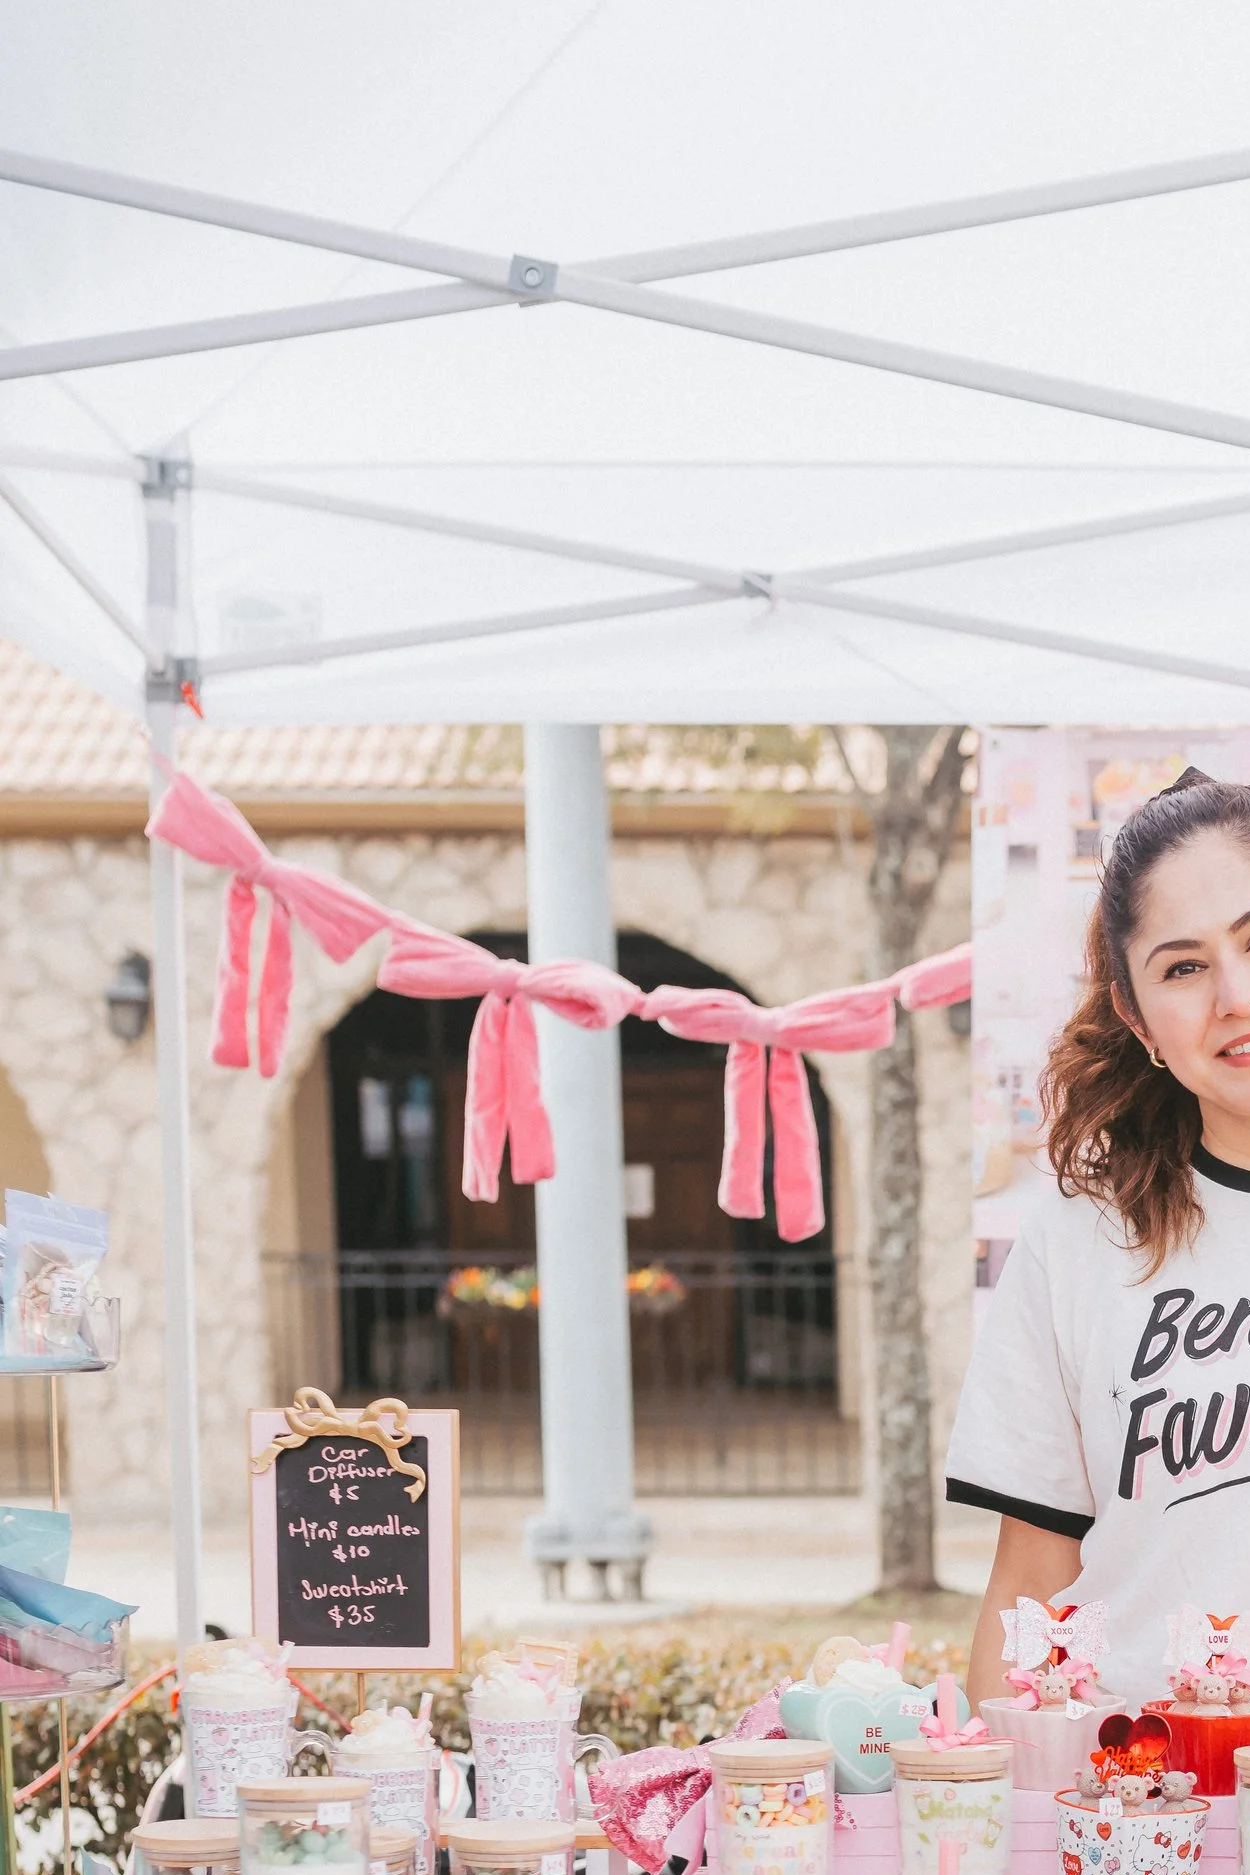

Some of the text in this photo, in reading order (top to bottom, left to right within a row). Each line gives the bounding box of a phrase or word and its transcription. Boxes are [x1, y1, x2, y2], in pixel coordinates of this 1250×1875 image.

[321, 1446, 369, 1462] Car
[308, 1463, 395, 1483] Diffuser
[329, 1483, 360, 1505] $5
[288, 1515, 421, 1547] Mini candles
[332, 1544, 370, 1563] $10
[301, 1574, 409, 1600] Sweatshirt
[327, 1604, 376, 1629] $35
[1050, 1627, 1074, 1636] XOXO
[1208, 1634, 1229, 1645] LOVE
[866, 1727, 883, 1738] BE
[859, 1742, 891, 1754] MINE
